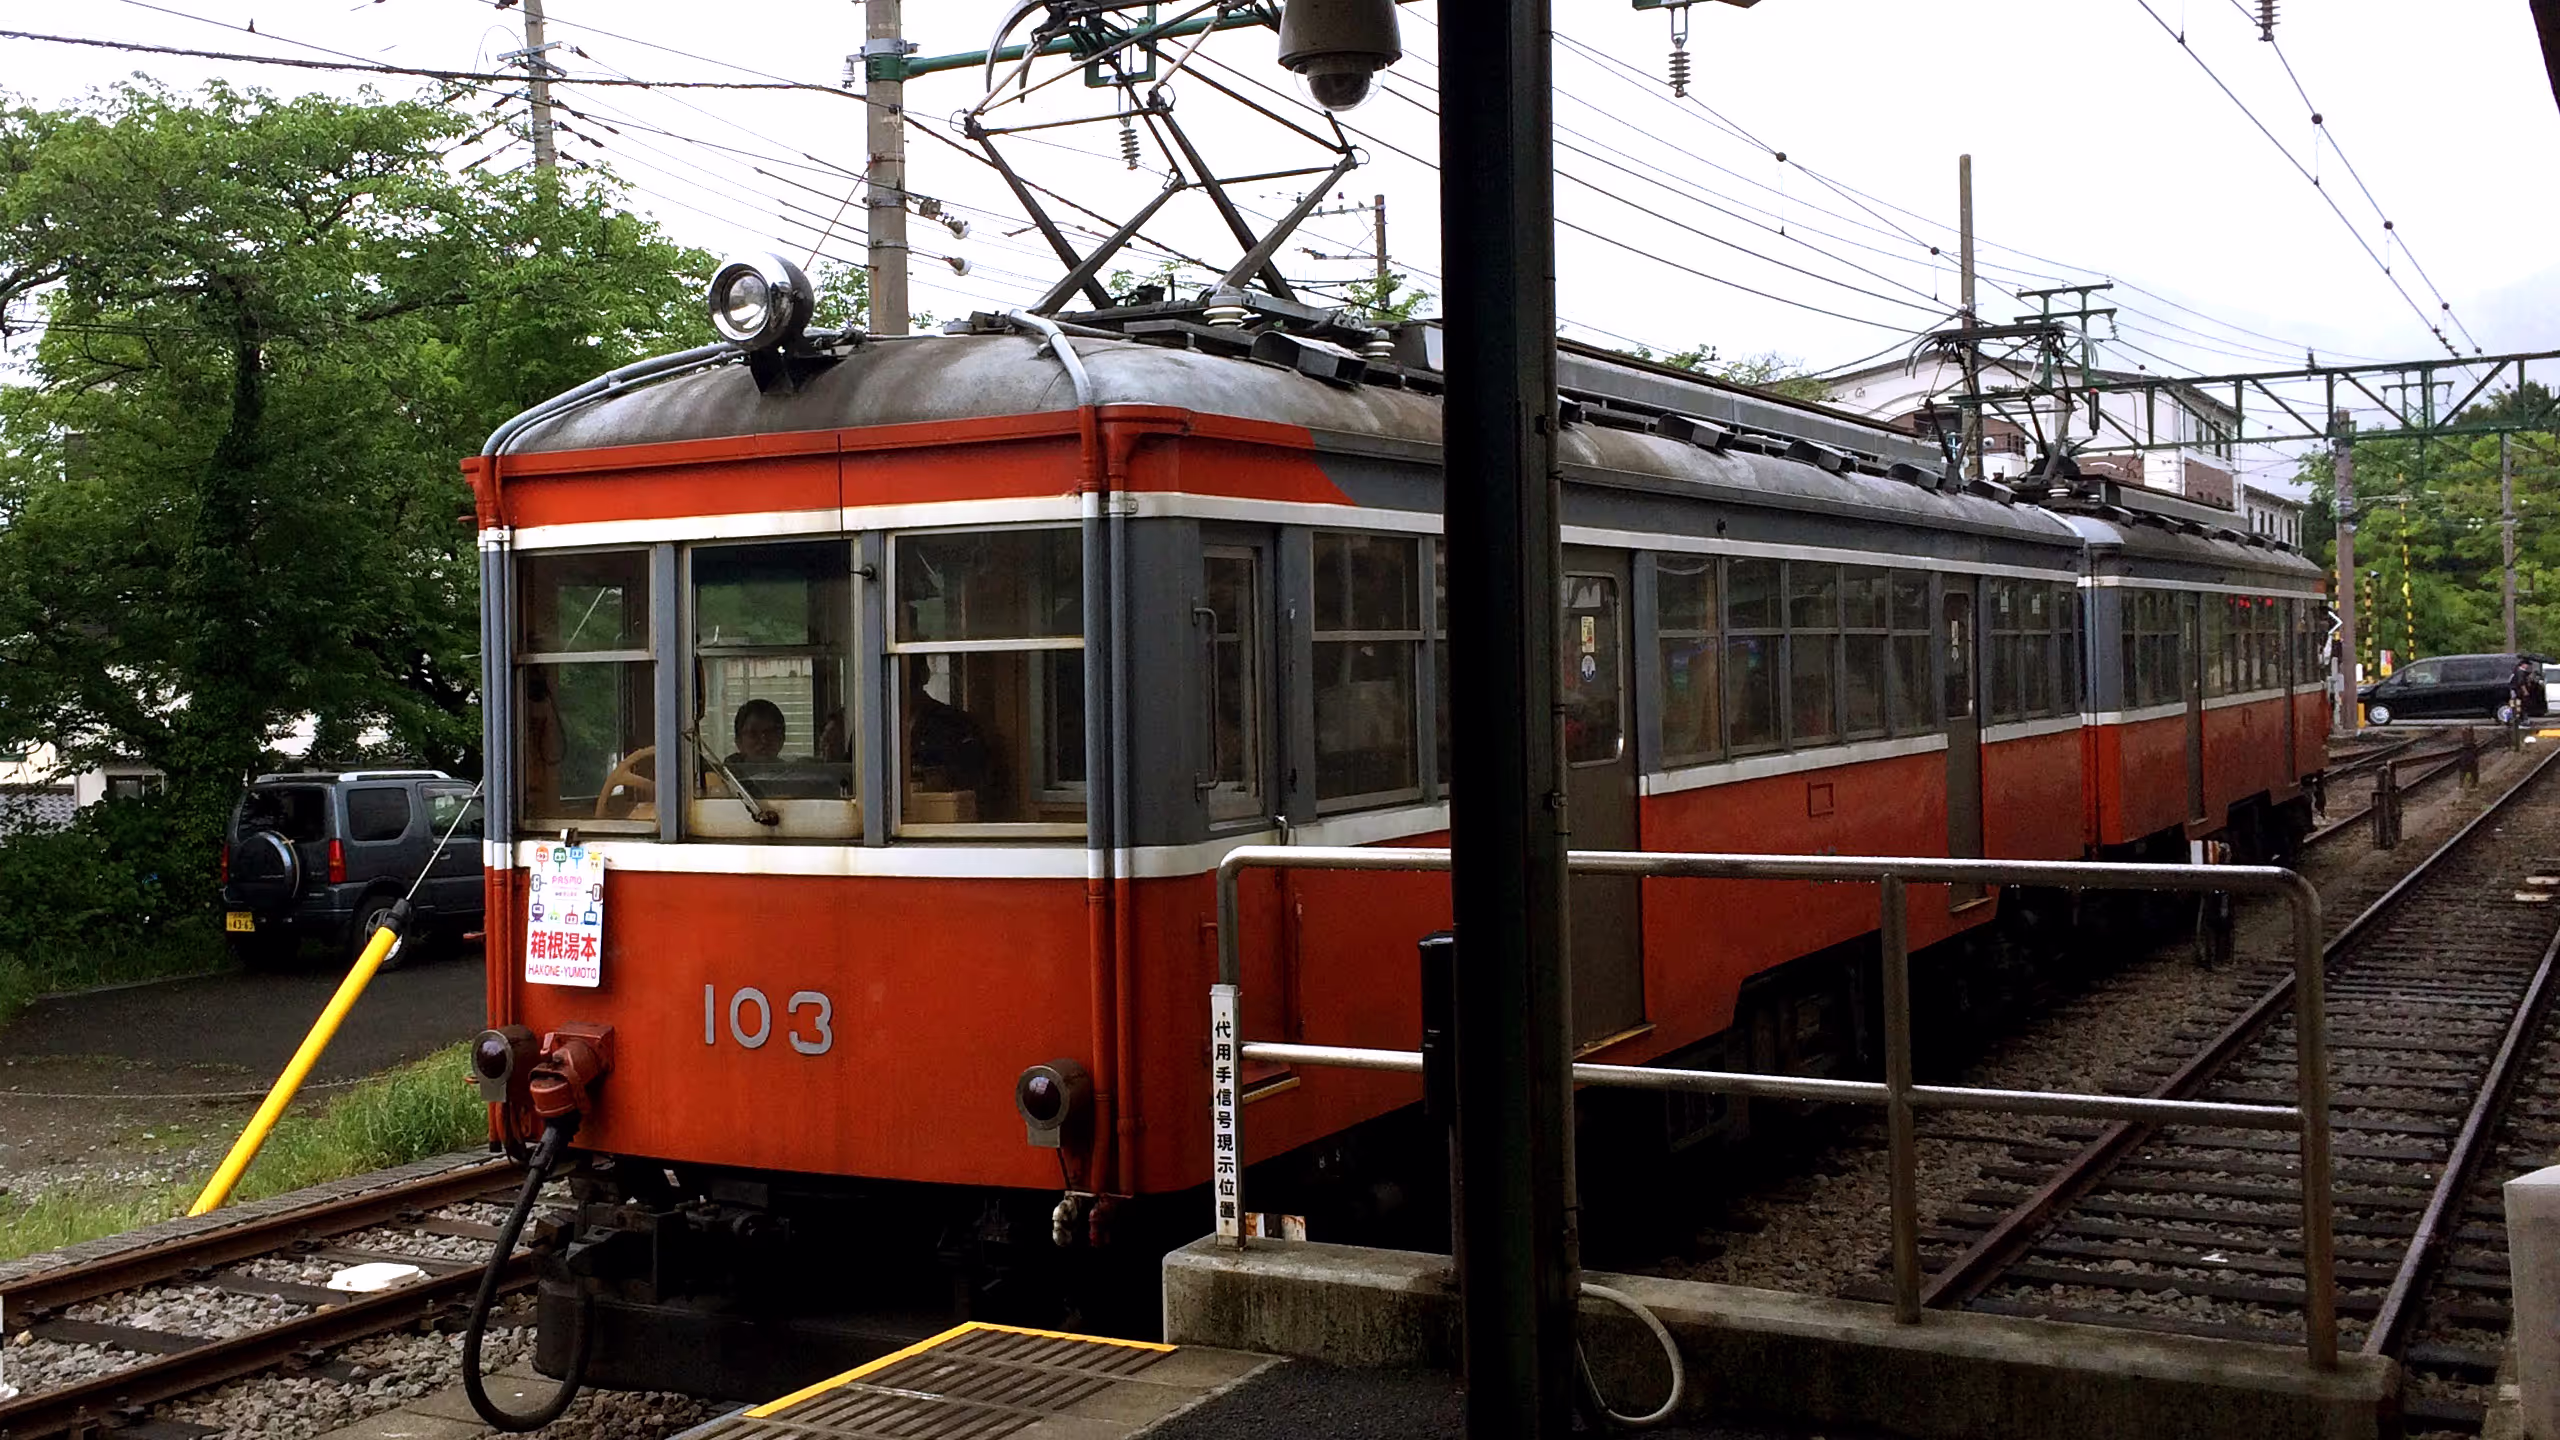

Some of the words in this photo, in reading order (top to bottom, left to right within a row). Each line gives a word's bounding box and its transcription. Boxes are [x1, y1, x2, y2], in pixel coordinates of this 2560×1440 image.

[530, 930, 597, 961] 箱根湯本
[705, 984, 833, 1055] 103
[1215, 1020, 1236, 1219] 代用手信号現示位置
